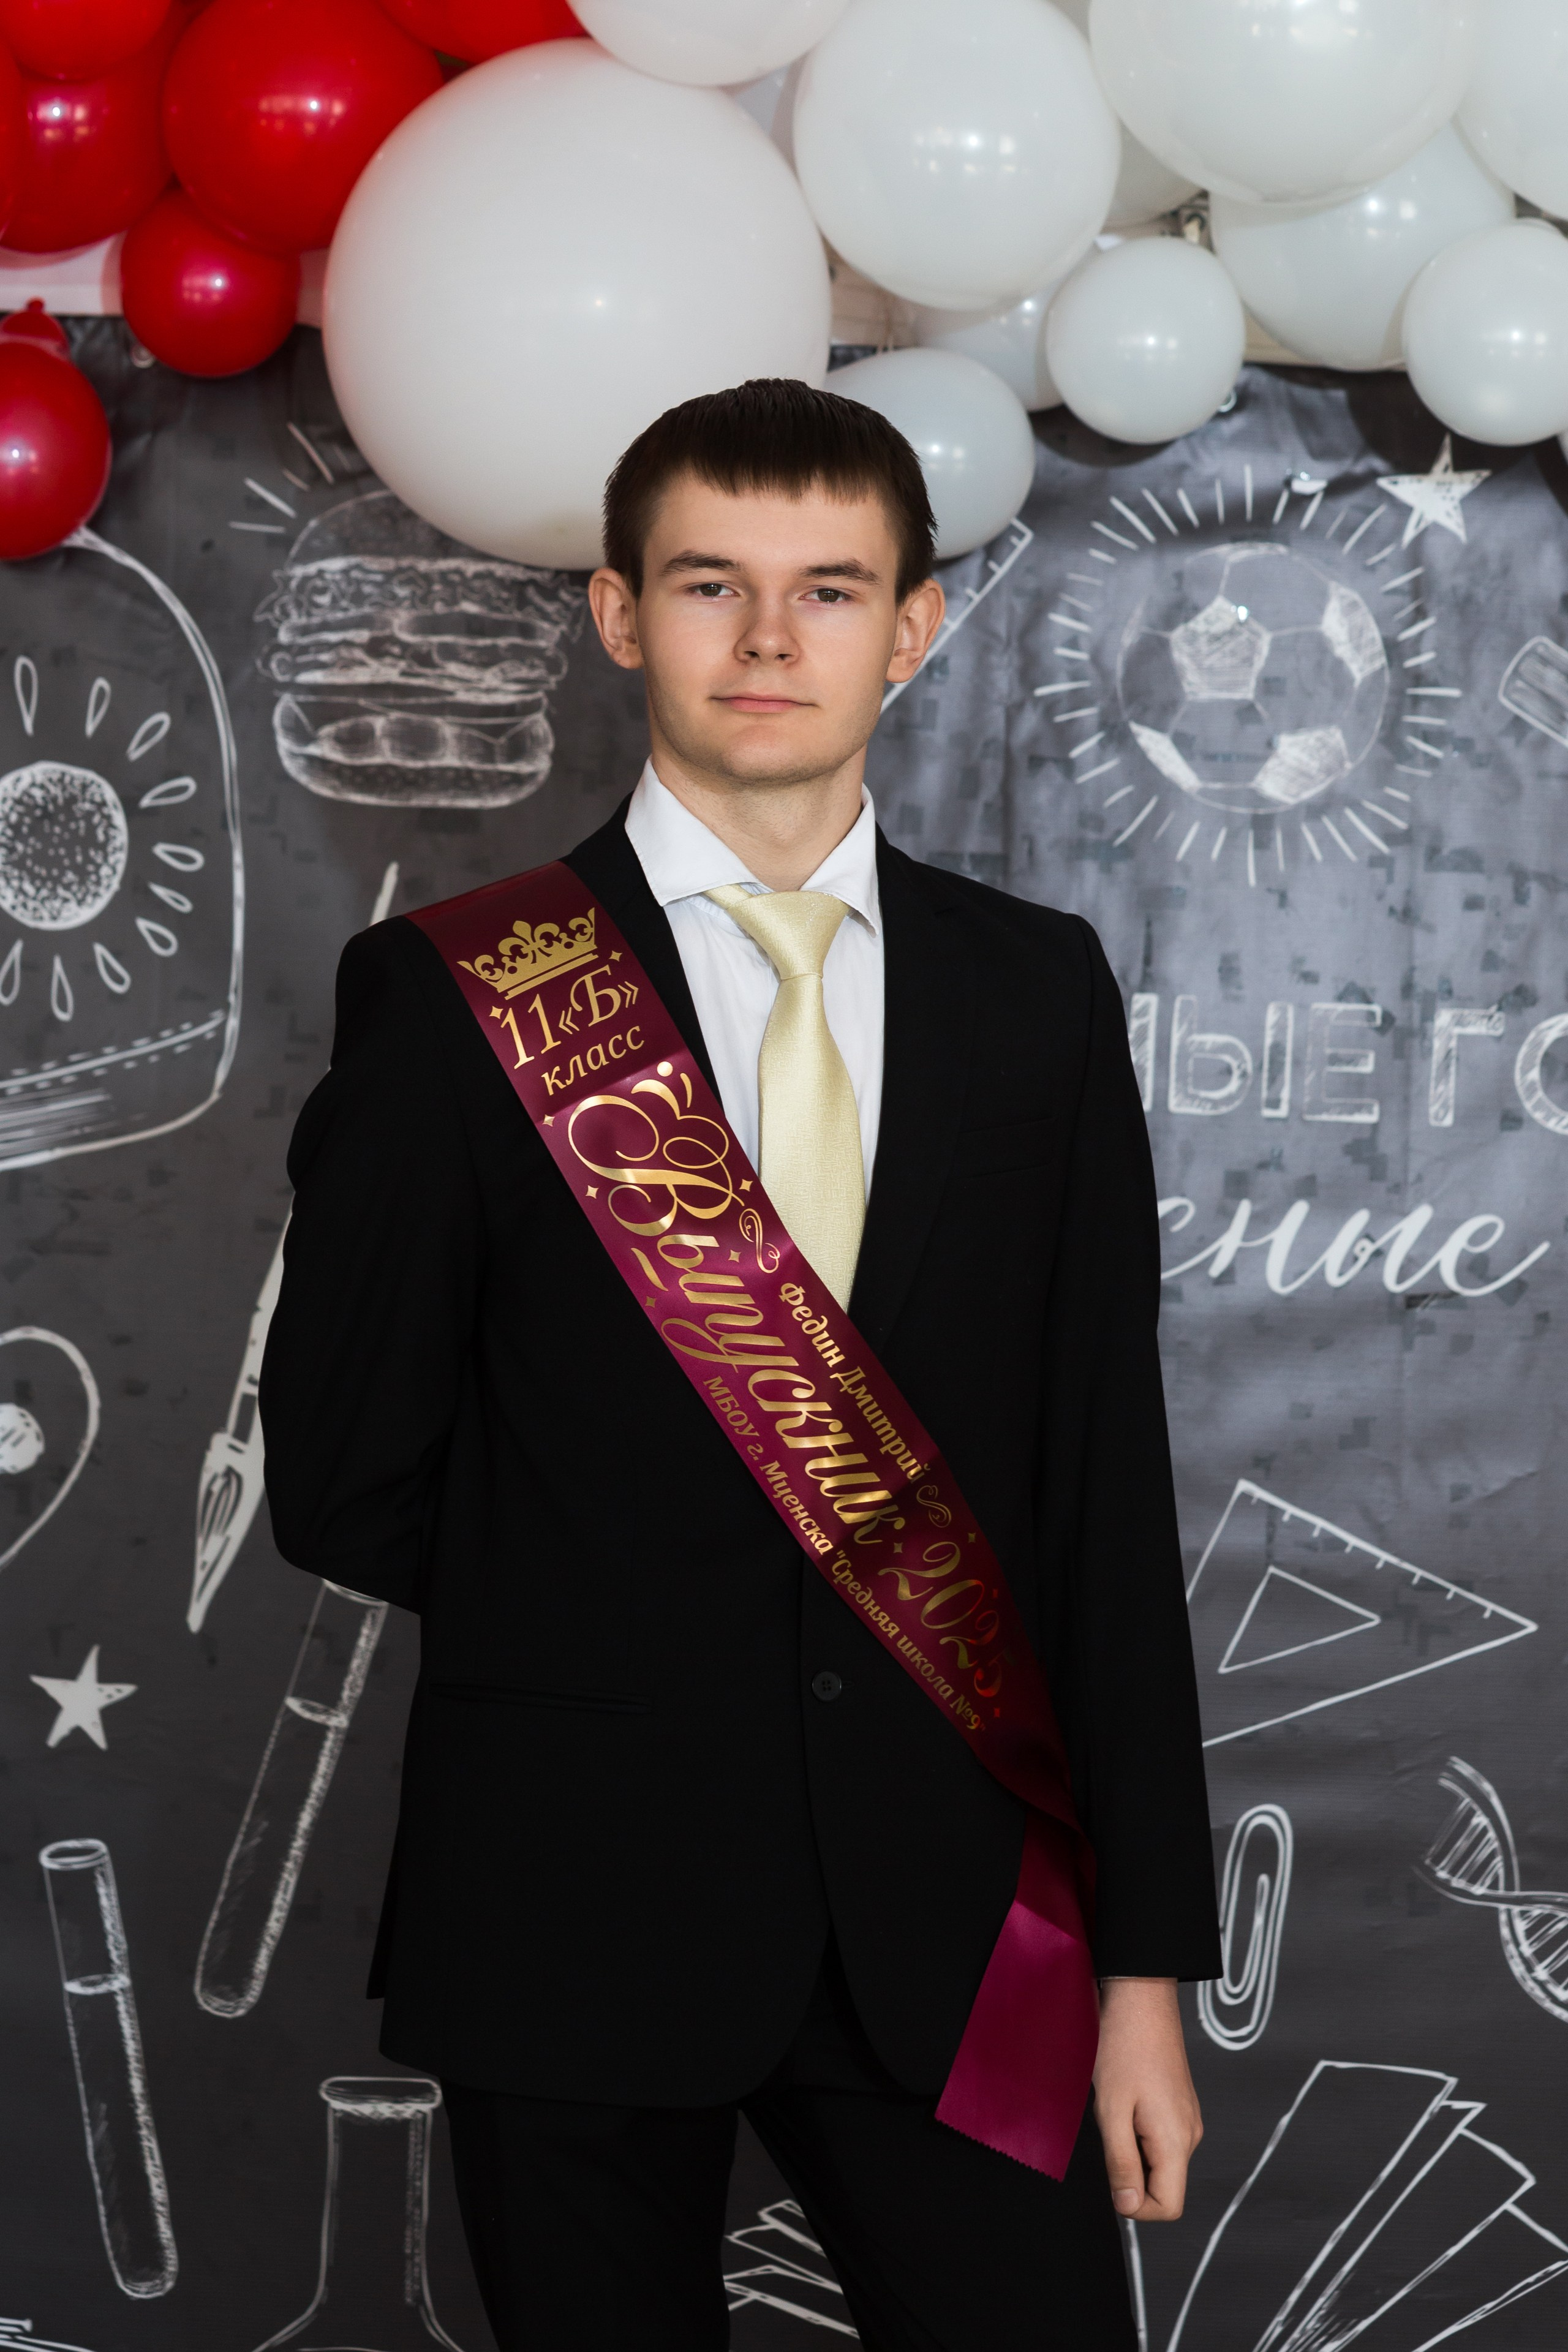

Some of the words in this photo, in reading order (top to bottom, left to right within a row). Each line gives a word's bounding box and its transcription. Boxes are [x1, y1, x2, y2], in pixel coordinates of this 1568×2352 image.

[500, 964, 639, 1069] 11«Б»
[541, 1025, 645, 1096] класс
[1128, 992, 1382, 1124] ЫЕ
[568, 1078, 906, 1545] Выпускник
[877, 1541, 1017, 1698] 2025
[778, 1283, 846, 1368] Федин
[829, 1366, 931, 1484] Дмитрий
[703, 1376, 760, 1437] МБОУ
[747, 1443, 764, 1461] г.
[759, 1460, 834, 1555] Мценска
[831, 1550, 900, 1639] "Средняя
[896, 1635, 954, 1700] школа
